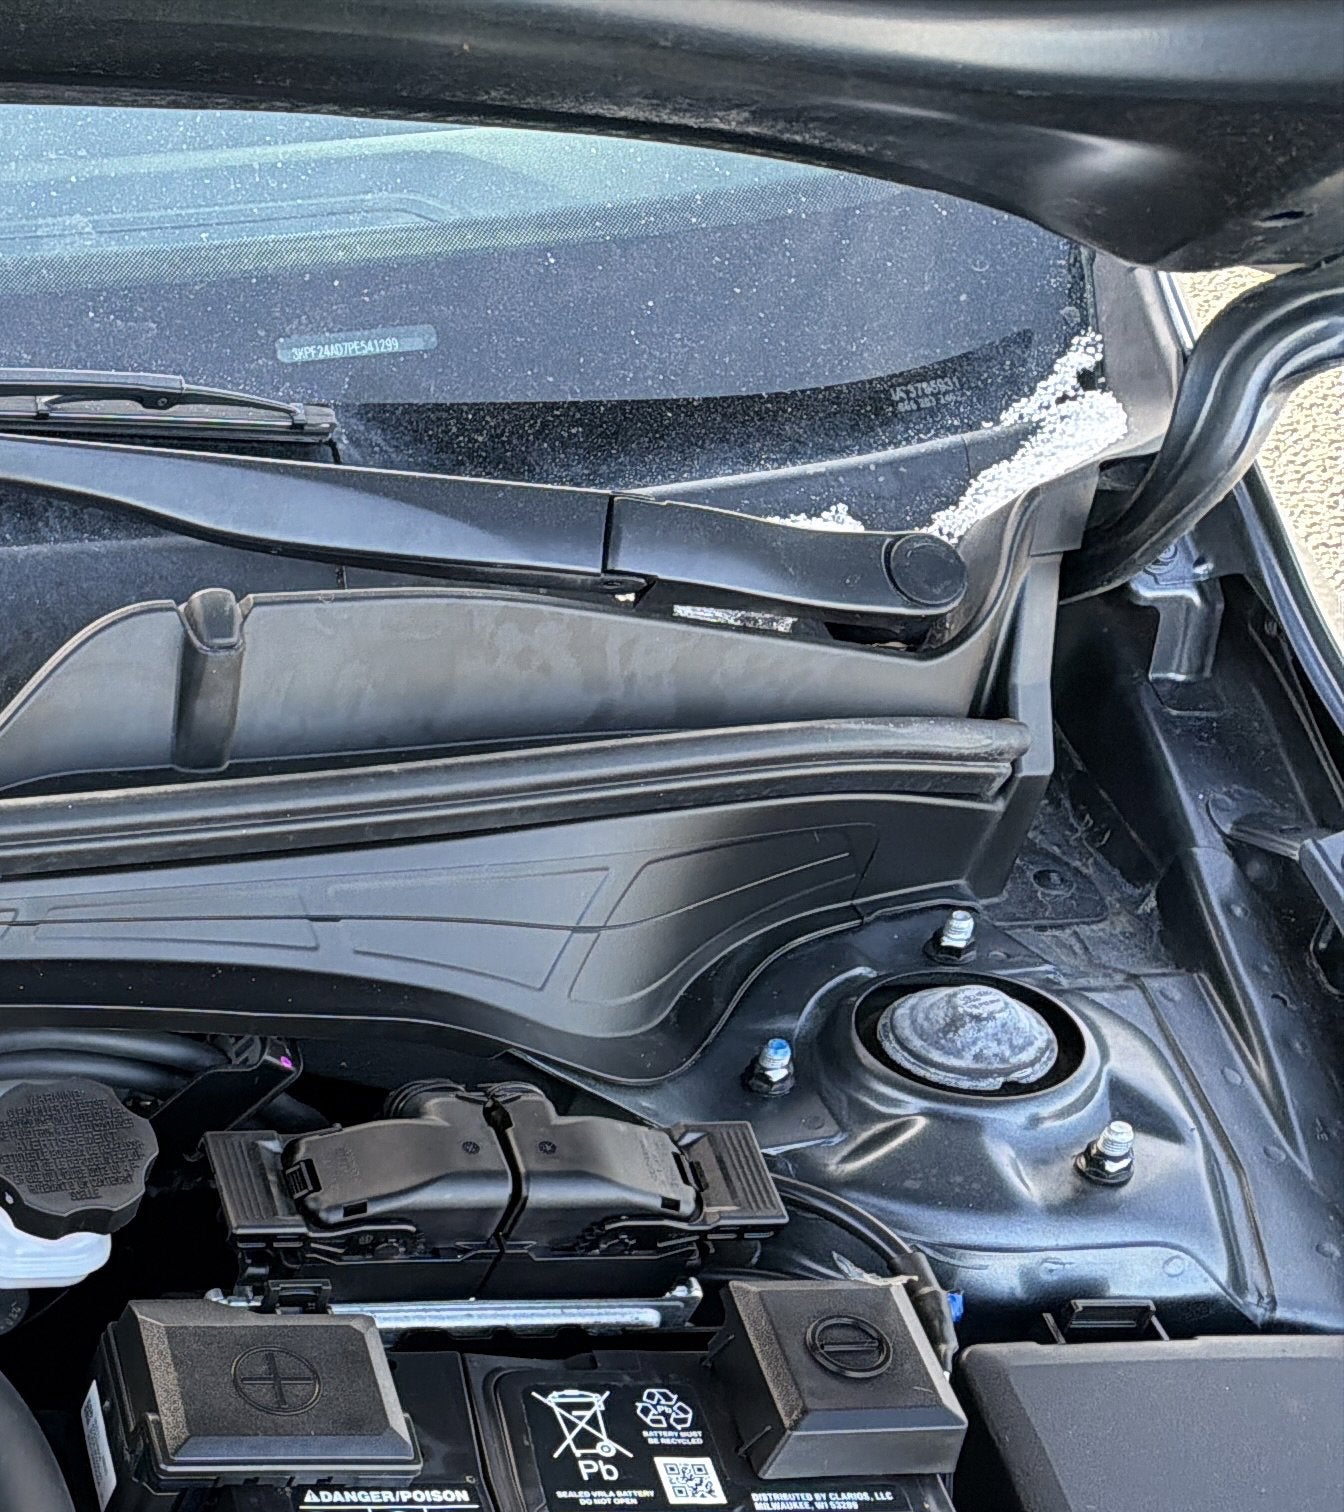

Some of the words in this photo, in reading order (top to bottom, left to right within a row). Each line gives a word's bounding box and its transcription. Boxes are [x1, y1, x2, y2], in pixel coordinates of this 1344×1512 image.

[678, 1430, 702, 1438] MUST
[578, 1460, 619, 1482] Pb
[319, 1490, 470, 1503] DANGER/POISON
[556, 1490, 589, 1498] SEALED
[591, 1490, 615, 1498] VRLA
[617, 1489, 654, 1498] BATTERY
[751, 1492, 813, 1502] DISTRIBUTED
[815, 1493, 827, 1501] BY
[829, 1492, 874, 1502] CLARIOS,
[875, 1491, 893, 1500] LLC
[755, 1501, 813, 1511] MILWAUKEE,
[815, 1501, 828, 1510] WI
